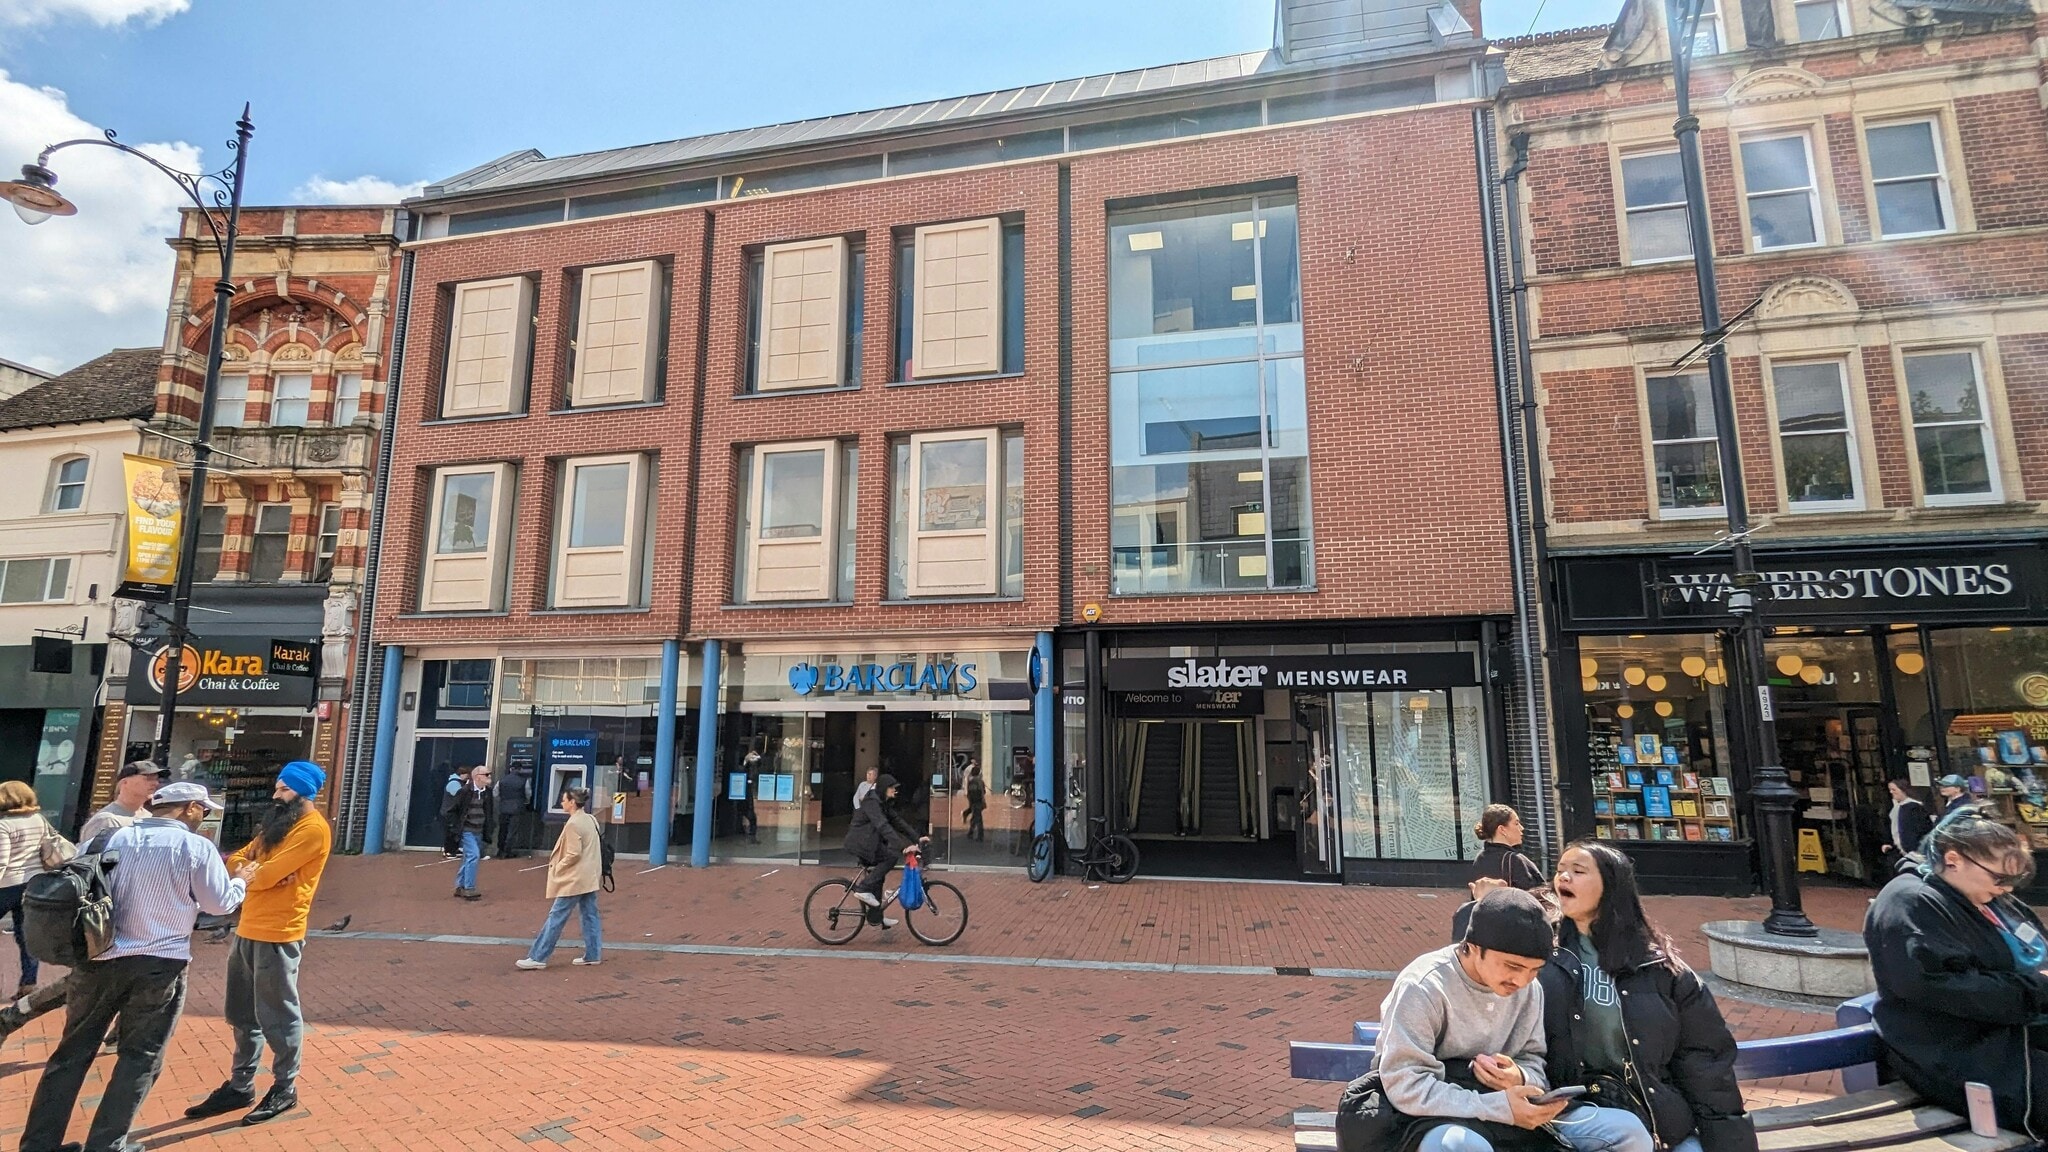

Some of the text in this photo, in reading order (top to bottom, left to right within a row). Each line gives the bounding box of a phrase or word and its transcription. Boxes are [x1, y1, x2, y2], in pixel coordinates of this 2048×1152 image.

[135, 517, 177, 529] FIND YOUR
[139, 525, 173, 536] FLAVOUR
[273, 645, 311, 662] Karak
[202, 650, 264, 675] Kara
[291, 664, 310, 672] Coffee
[824, 663, 977, 692] BARCLAYS
[1167, 658, 1408, 688] slater MENSWEAR
[199, 677, 280, 690] Chai & Coffee
[1125, 692, 1182, 703] Welcome to
[1761, 688, 1770, 718] 4923
[560, 739, 590, 747] BARCLAYS
[1444, 847, 1470, 857] Hoe
